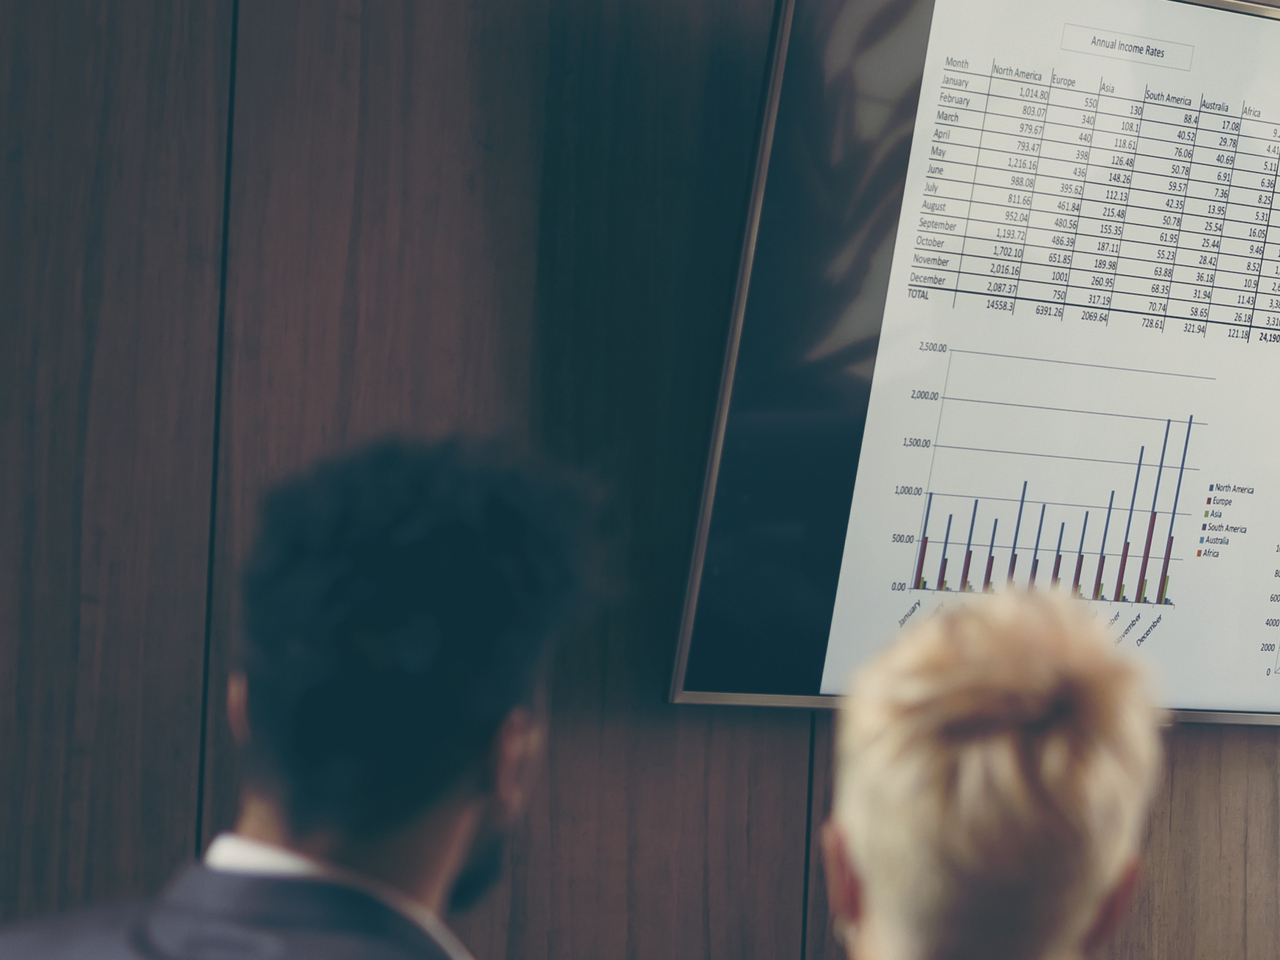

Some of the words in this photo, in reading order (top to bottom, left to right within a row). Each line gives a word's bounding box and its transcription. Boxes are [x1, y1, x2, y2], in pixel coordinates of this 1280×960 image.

[1091, 36, 1116, 49] Annual
[1118, 40, 1144, 54] Income
[1146, 45, 1164, 58] Rates
[946, 57, 969, 69] Month
[994, 65, 1013, 76] North
[1015, 68, 1042, 81] America
[1052, 74, 1075, 87] Europe
[1101, 83, 1114, 93] Asia
[1146, 90, 1164, 101] South
[1166, 93, 1192, 106] America
[1202, 100, 1229, 112] Australia
[1243, 106, 1261, 117] Africa
[942, 75, 969, 89] January
[1020, 87, 1048, 100] 1,014.80
[1084, 98, 1097, 108] 550
[1130, 105, 1143, 116] 130
[1183, 114, 1198, 124] 88.4
[1222, 121, 1240, 131] 17.08
[940, 92, 970, 107] February
[1022, 105, 1045, 118] 803.07
[1082, 115, 1094, 125] 340
[1121, 122, 1139, 133] 108.1
[1177, 131, 1196, 141] 40.52
[1219, 137, 1237, 148] 29.78
[1266, 145, 1279, 155] 4.41
[937, 111, 958, 122] March
[1020, 124, 1042, 136] 979.67
[1079, 133, 1091, 143] 440
[1115, 139, 1136, 150] 118.61
[1174, 148, 1193, 159] 76.06
[1216, 154, 1234, 165] 40.69
[1264, 162, 1277, 172] 5.11
[933, 129, 950, 139] April
[1017, 141, 1039, 153] 793.47
[1076, 150, 1089, 160] 398
[1112, 156, 1134, 168] 126.48
[1171, 165, 1190, 176] 50.78
[1217, 172, 1231, 182] 6.91
[1261, 178, 1274, 188] 6.36
[931, 146, 946, 158] May
[1008, 158, 1037, 170] 1,216.16
[1073, 167, 1086, 177] 436
[1109, 173, 1131, 184] 148.26
[1168, 182, 1186, 192] 59.57
[1214, 188, 1228, 198] 7.36
[1258, 195, 1271, 205] 8.25
[928, 164, 943, 175] June
[1011, 176, 1034, 188] 988.08
[1060, 183, 1083, 195] 395.62
[1106, 190, 1128, 201] 112.13
[1166, 198, 1184, 209] 42.35
[1208, 205, 1226, 216] 13.95
[1255, 212, 1268, 222] 5.31
[925, 182, 938, 193] July
[1008, 194, 1031, 206] 811.66
[1057, 201, 1080, 212] 461.84
[1103, 207, 1125, 219] 215.48
[1163, 216, 1181, 227] 50.78
[1205, 222, 1222, 232] 25.54
[1249, 228, 1265, 239] 16.05
[922, 200, 946, 212] August
[1005, 211, 1028, 223] 952.04
[1054, 218, 1077, 229] 480.56
[1100, 224, 1122, 236] 155.35
[1160, 233, 1178, 243] 61.95
[1202, 238, 1219, 249] 25.44
[1249, 245, 1263, 255] 9.46
[919, 218, 957, 231] September
[996, 228, 1025, 241] 1,193.72
[1052, 236, 1074, 247] 486.39
[1097, 242, 1119, 253] 187.11
[1157, 250, 1175, 260] 55.23
[1199, 255, 1217, 266] 28.42
[1247, 262, 1260, 272] 8.52
[916, 236, 944, 247] October
[994, 246, 1022, 259] 1,702.10
[1049, 253, 1071, 264] 651.85
[1094, 259, 1116, 270] 189.98
[1154, 267, 1172, 278] 63.88
[1196, 272, 1214, 283] 36.18
[1244, 279, 1257, 288] 10.9
[914, 254, 949, 266] November
[990, 263, 1019, 276] 2,016.16
[1052, 271, 1068, 282] 1001
[1091, 277, 1113, 288] 260.95
[1151, 284, 1169, 294] 68.35
[1193, 289, 1211, 300] 31.94
[1238, 295, 1255, 306] 11.43
[910, 273, 946, 285] December
[987, 282, 1017, 294] 2,087.37
[1053, 290, 1065, 300] 750
[1089, 294, 1110, 306] 317.19
[1148, 302, 1166, 312] 70.74
[1190, 307, 1208, 318] 58.65
[1234, 312, 1251, 323] 26.18
[908, 289, 929, 299] TOTAL
[987, 299, 1013, 312] 14558.3
[1036, 305, 1063, 317] 6391.26
[1081, 311, 1108, 322] 2069.64
[1142, 318, 1163, 329] 728.61
[1184, 323, 1205, 334] 321.94
[1228, 329, 1249, 340] 121.18
[919, 342, 947, 353] 2,500.00
[911, 390, 939, 400] 2,000.00
[903, 438, 930, 448] 1,500.00
[895, 486, 922, 496] 1,000.00
[1212, 497, 1232, 506] Europe
[1215, 483, 1231, 493] North
[1232, 485, 1254, 495] America
[1210, 510, 1222, 518] Asia
[891, 534, 914, 544] 500.00
[1205, 536, 1229, 545] Australia
[1208, 523, 1223, 532] South
[1225, 525, 1247, 534] America
[1203, 549, 1219, 558] Africa
[891, 583, 906, 591] 0.00
[1135, 614, 1163, 647] December
[1265, 619, 1280, 627] 4000
[1261, 644, 1275, 652] 2000
